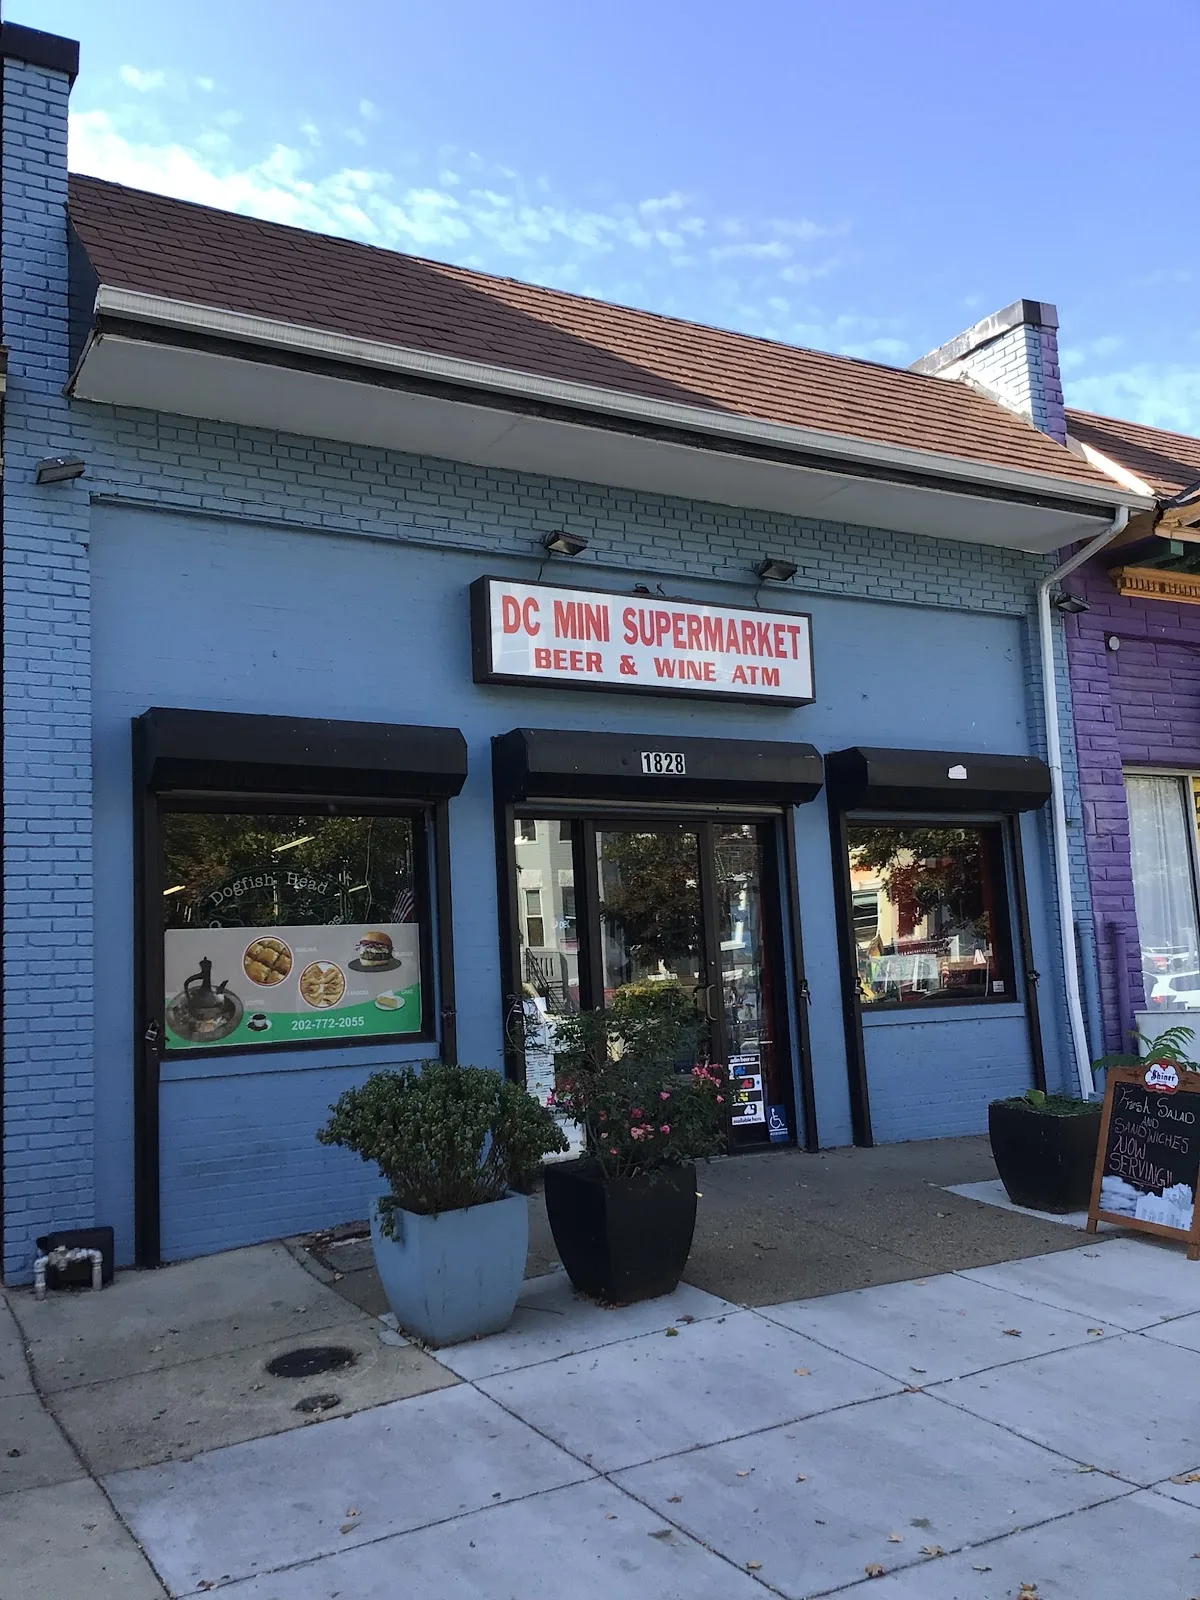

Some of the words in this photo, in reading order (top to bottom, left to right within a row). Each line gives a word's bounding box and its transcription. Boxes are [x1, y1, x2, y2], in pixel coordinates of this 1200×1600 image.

[502, 595, 540, 636] DC
[554, 600, 610, 642] MINI
[623, 607, 800, 659] SUPERMARKET
[534, 648, 603, 672] BEER
[619, 655, 638, 676] &
[653, 657, 716, 682] WINE
[732, 664, 780, 687] ATM
[643, 753, 684, 773] 1828
[208, 873, 276, 906] Dogfish
[286, 871, 329, 895] Head
[291, 1016, 364, 1031] 202-772-2055
[1151, 1070, 1175, 1082] Shiner
[1141, 1116, 1159, 1129] AND
[1113, 1135, 1146, 1160] NOW
[1114, 1117, 1189, 1154] SANDWICHES
